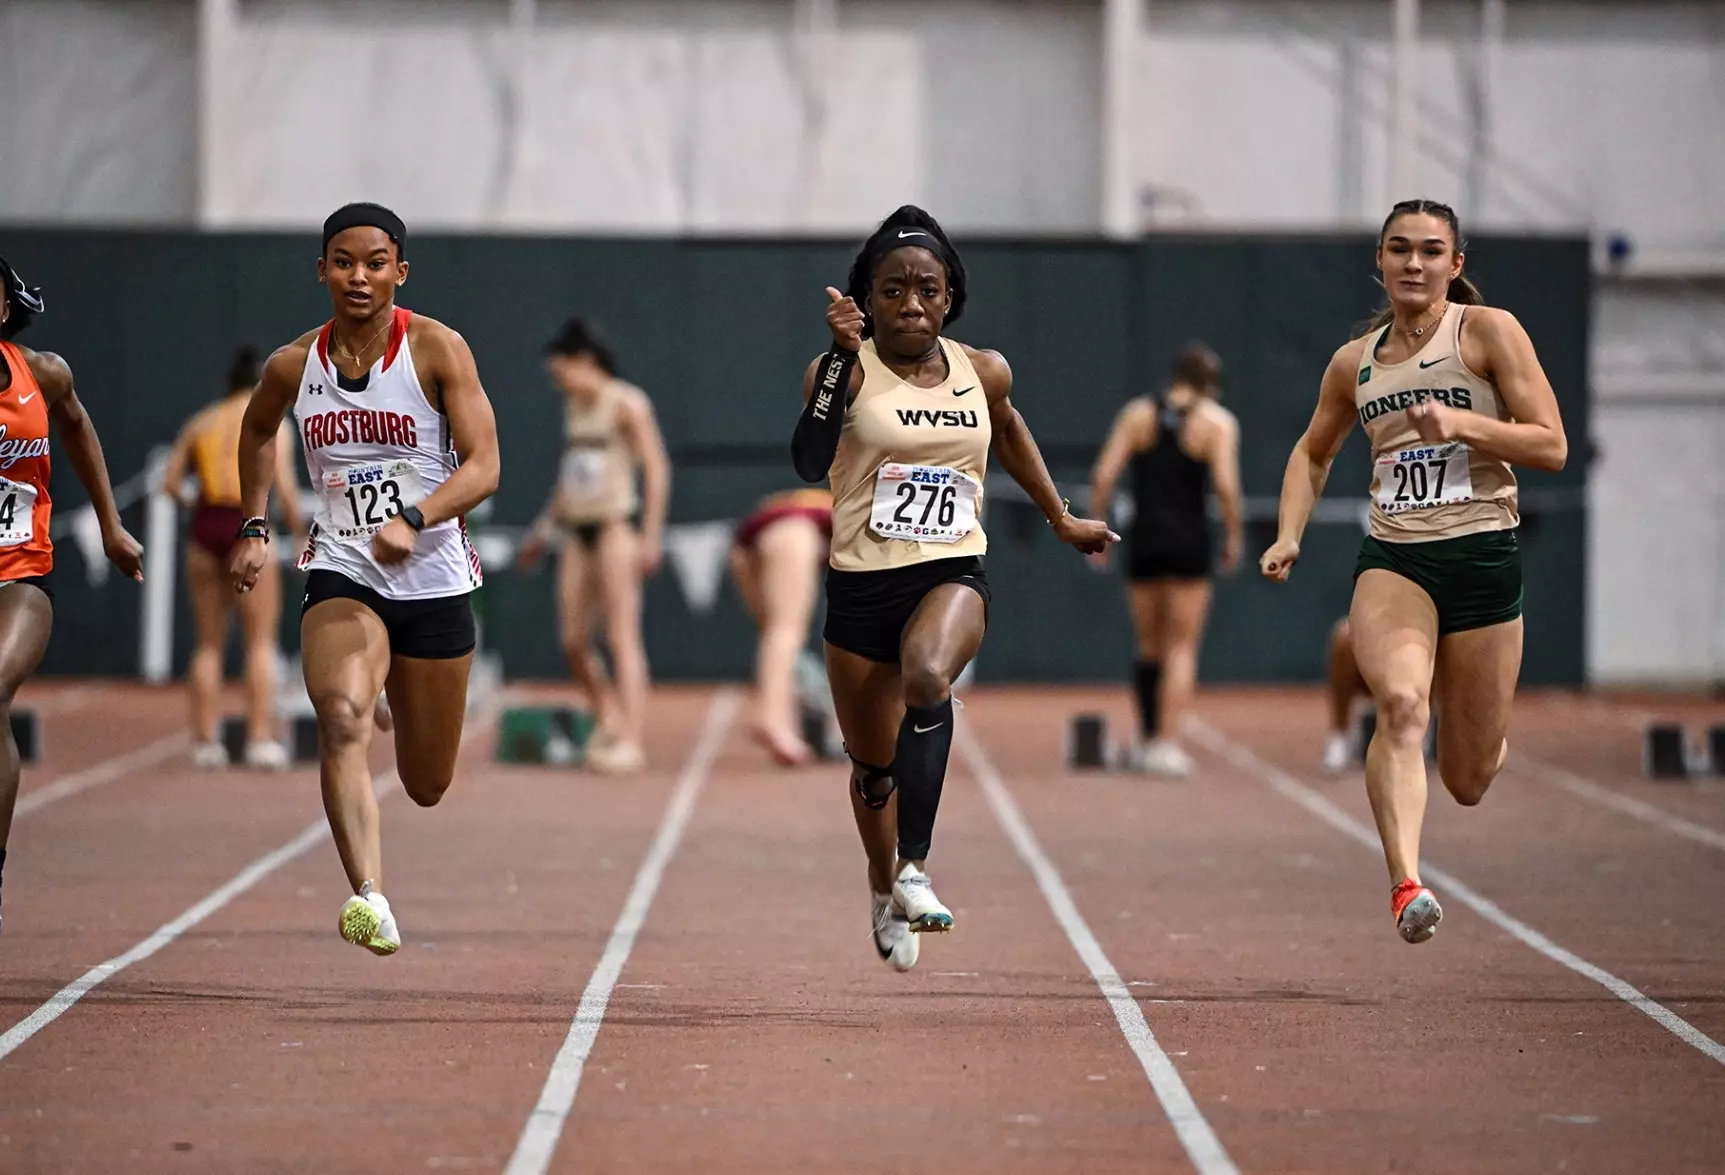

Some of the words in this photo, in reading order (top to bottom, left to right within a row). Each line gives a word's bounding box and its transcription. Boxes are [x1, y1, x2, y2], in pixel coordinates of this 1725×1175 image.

[813, 389, 833, 420] THE
[896, 409, 978, 428] WVSU
[1358, 387, 1472, 425] IONEERS
[304, 410, 418, 452] FROSTBURG
[1400, 449, 1434, 462] EAST
[348, 469, 383, 485] EAST
[911, 472, 949, 484] EAST
[1394, 460, 1447, 502] 207
[345, 480, 405, 527] 123
[893, 482, 956, 527] 276
